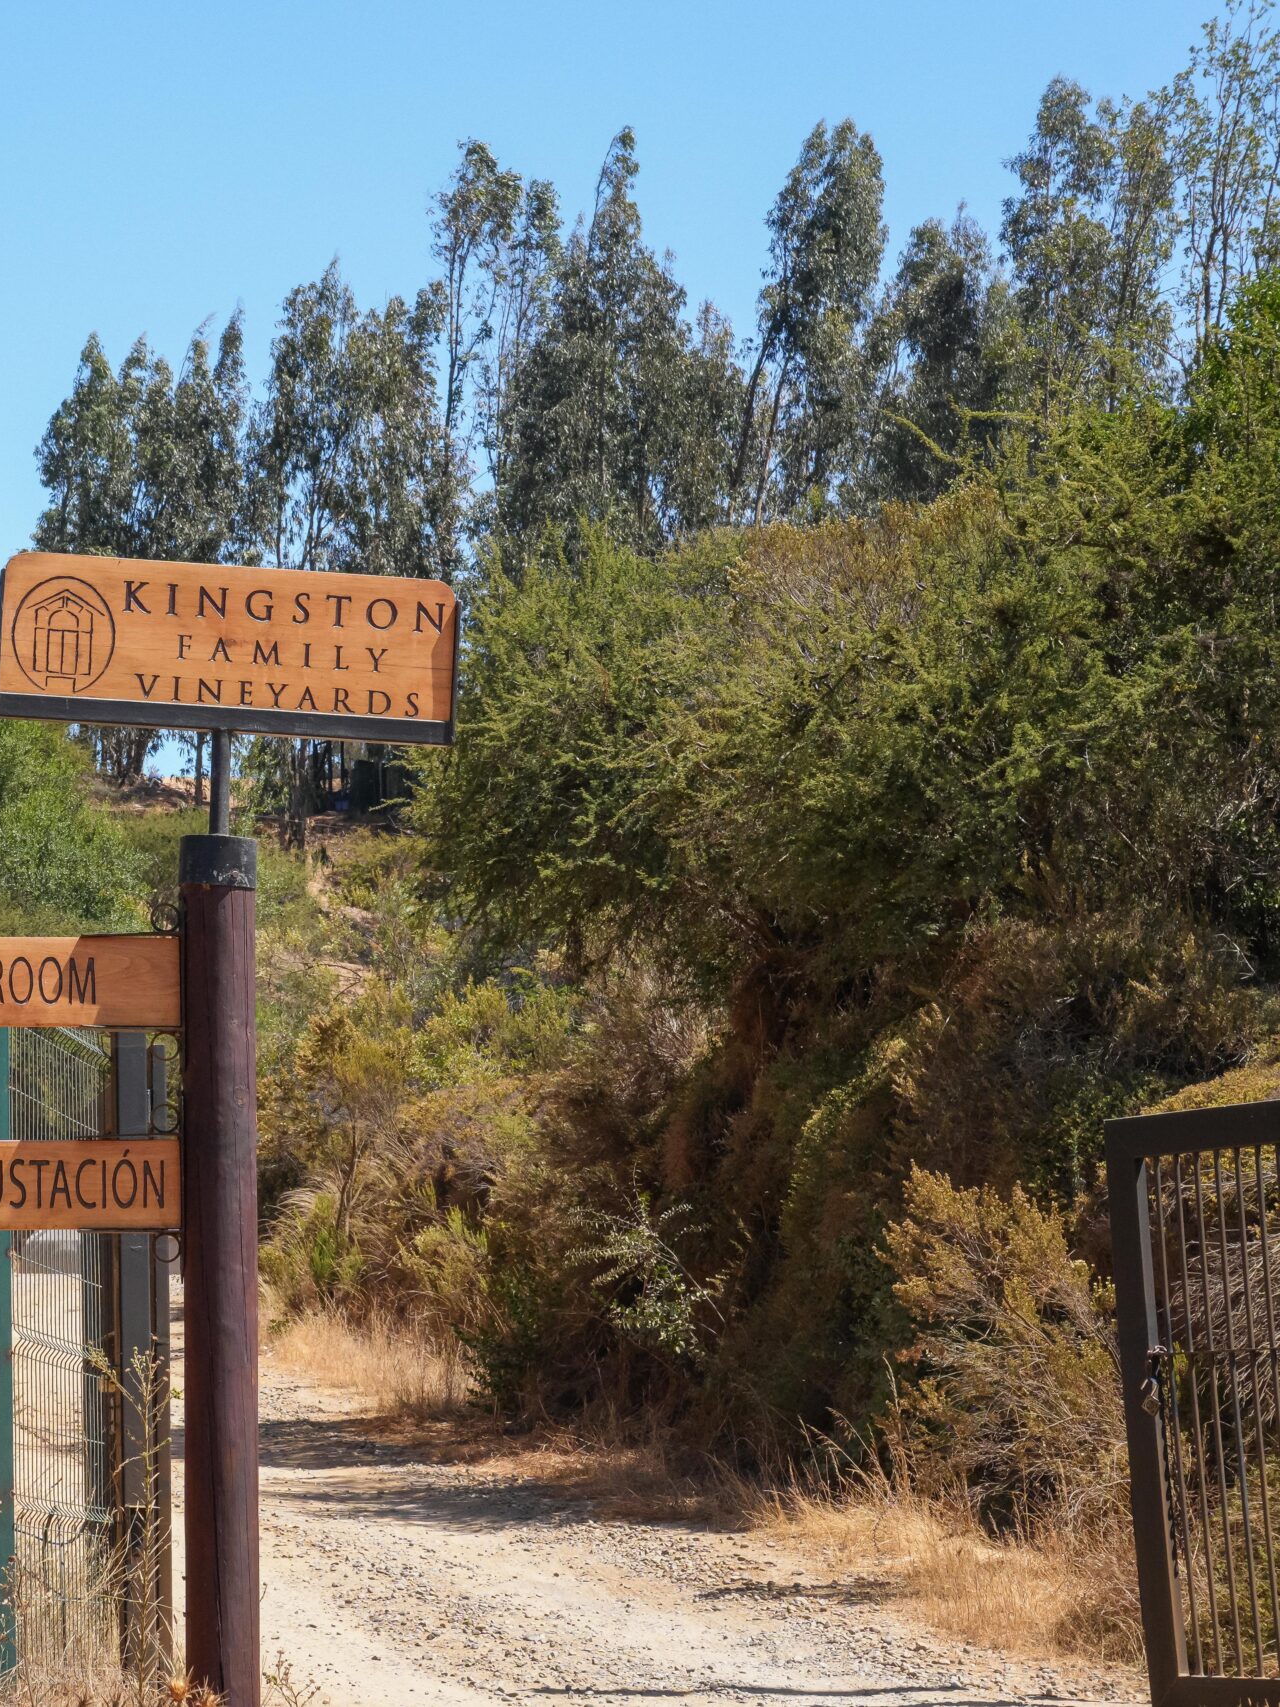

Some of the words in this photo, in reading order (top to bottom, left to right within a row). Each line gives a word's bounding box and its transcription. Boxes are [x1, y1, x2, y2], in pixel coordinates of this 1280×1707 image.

[122, 580, 446, 634] KINGSTON
[177, 634, 389, 673] FAMILY
[135, 673, 420, 718] VINEYARDS
